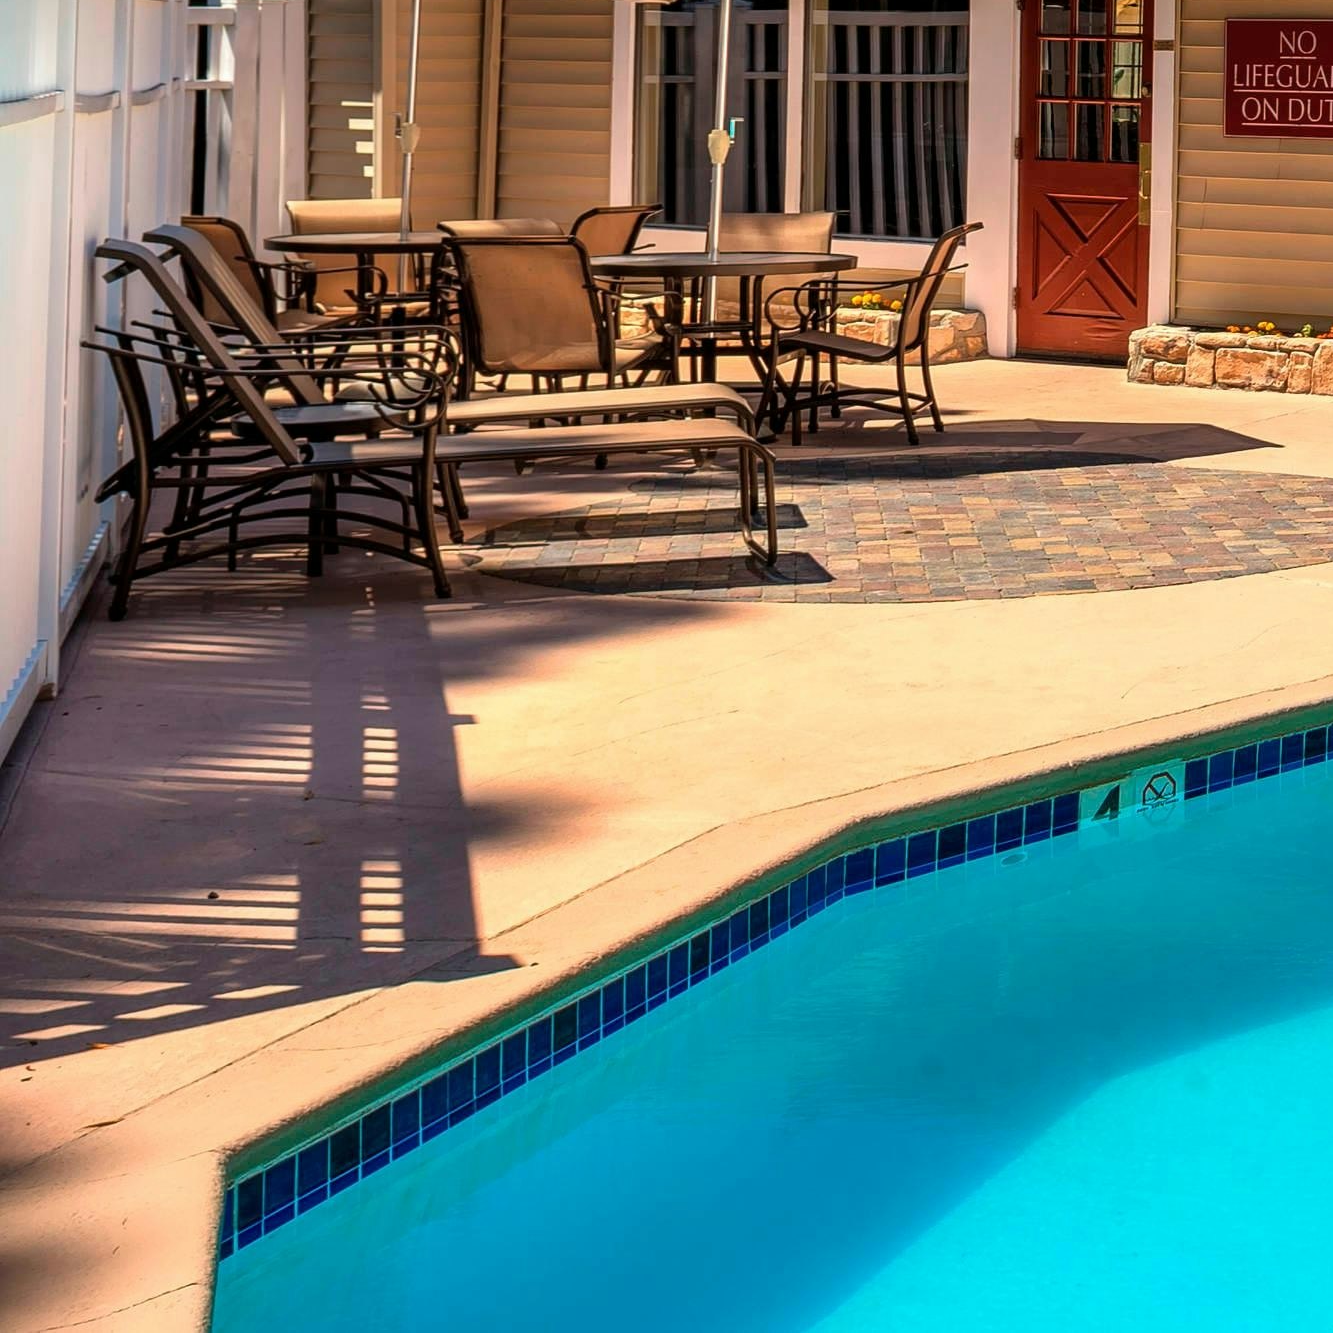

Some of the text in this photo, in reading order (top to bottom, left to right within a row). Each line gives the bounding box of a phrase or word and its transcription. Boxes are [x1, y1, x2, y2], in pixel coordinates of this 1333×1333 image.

[1280, 30, 1317, 54] NO
[1241, 97, 1279, 121] ON
[1091, 783, 1120, 821] 4
